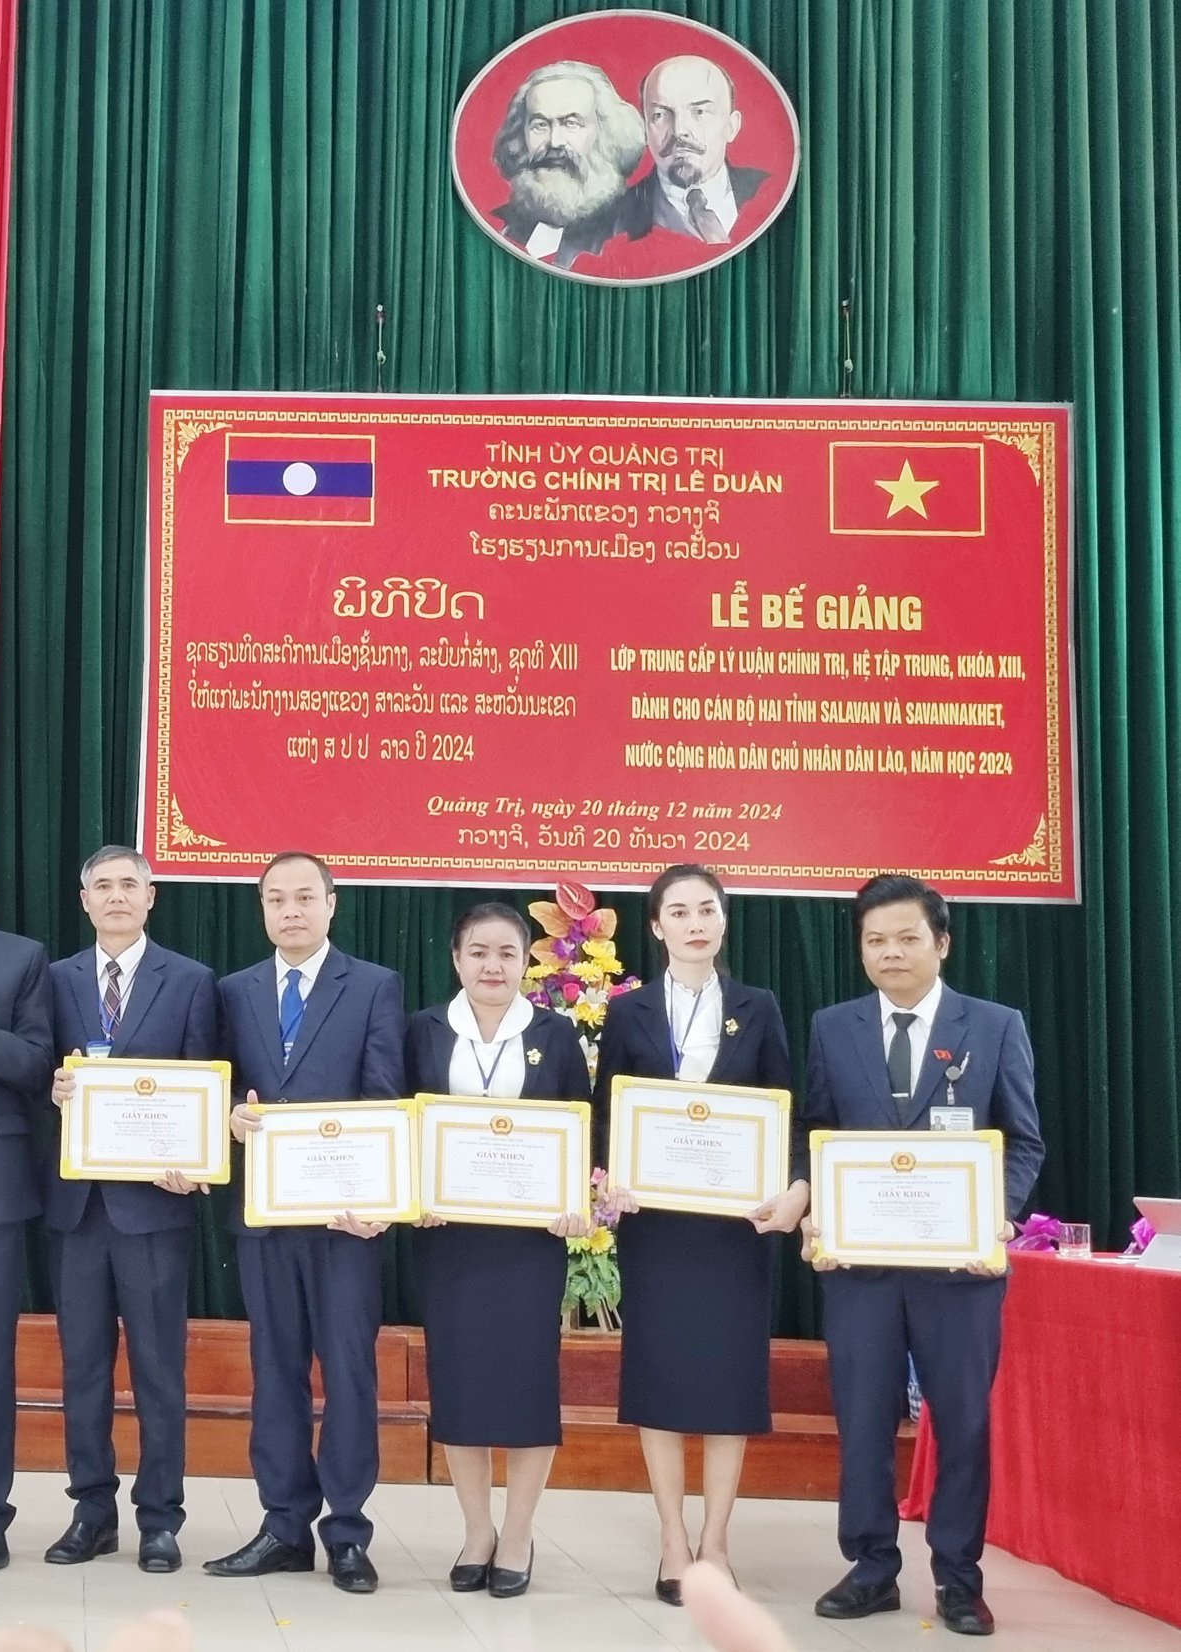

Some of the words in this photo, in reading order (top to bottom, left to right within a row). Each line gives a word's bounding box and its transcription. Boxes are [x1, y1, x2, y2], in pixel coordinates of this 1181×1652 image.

[486, 441, 540, 463] TỈNH
[550, 443, 582, 463] ỦY
[589, 444, 677, 466] QUẢNG
[686, 448, 723, 470] TRỊ
[428, 467, 536, 489] TRƯỜNG
[544, 468, 620, 490] CHÍNH
[628, 473, 666, 495] TRỊ
[676, 470, 704, 492] LÊ
[334, 577, 483, 619] ພິທີປິດ
[712, 581, 749, 627] LỄ
[762, 584, 806, 628] BẾ
[817, 584, 921, 630] GIẢNG
[550, 644, 577, 669] XIII
[611, 644, 636, 671] LỚP
[640, 649, 684, 672] TRUNG
[689, 643, 715, 672] CẤP
[720, 647, 735, 672] LÝ
[739, 647, 774, 678] LUẬN
[779, 649, 819, 674] CHÍNH
[824, 653, 849, 679] TRỊ,
[853, 649, 870, 681] HỆ
[874, 649, 900, 680] TẬP
[904, 655, 953, 679] TRUNG,
[958, 651, 994, 677] KHÓA
[999, 656, 1025, 680] XIII,
[376, 684, 433, 713] ສາລະວັນ
[440, 693, 468, 713] ແລະ
[632, 693, 668, 719] DÀNH
[673, 698, 700, 720] CHO
[705, 695, 732, 720] CÁN
[737, 696, 754, 726] BỘ
[759, 700, 781, 721] HAI
[785, 693, 816, 722] TỈNH
[821, 701, 880, 723] SALAVAN
[884, 698, 901, 724] VÀ
[906, 702, 1004, 728] SAVANNAKHET,
[288, 730, 317, 764] ແຫ່ງ
[325, 738, 334, 758] ສ
[341, 733, 351, 759] ປ
[358, 734, 368, 759] ປ
[381, 739, 409, 759] ລາວ
[416, 730, 426, 759] ປີ
[433, 735, 474, 761] 2024
[626, 741, 662, 767] NƯỚC
[667, 742, 704, 772] CỘNG
[708, 742, 735, 769] HÒA
[739, 743, 767, 769] DÂN
[772, 741, 798, 770] CHỦ
[803, 744, 841, 771] NHÂN
[846, 745, 873, 771] DÂN
[878, 746, 907, 775] LÀO,
[911, 747, 943, 773] NĂM
[947, 751, 975, 778] HỌC
[979, 752, 1012, 774] 2024
[496, 798, 525, 817] Trị,
[532, 799, 575, 818] ngày
[581, 800, 602, 815] 20
[607, 801, 659, 821] tháng
[667, 802, 686, 817] 12
[693, 804, 732, 818] năm
[738, 804, 782, 819] 2024
[539, 824, 585, 846] ວັນທີ
[593, 829, 620, 848] 20
[630, 827, 685, 849] ທັນວາ
[695, 831, 750, 851] 2024
[500, 1153, 525, 1161] KHEN
[697, 1140, 722, 1148] KHEN
